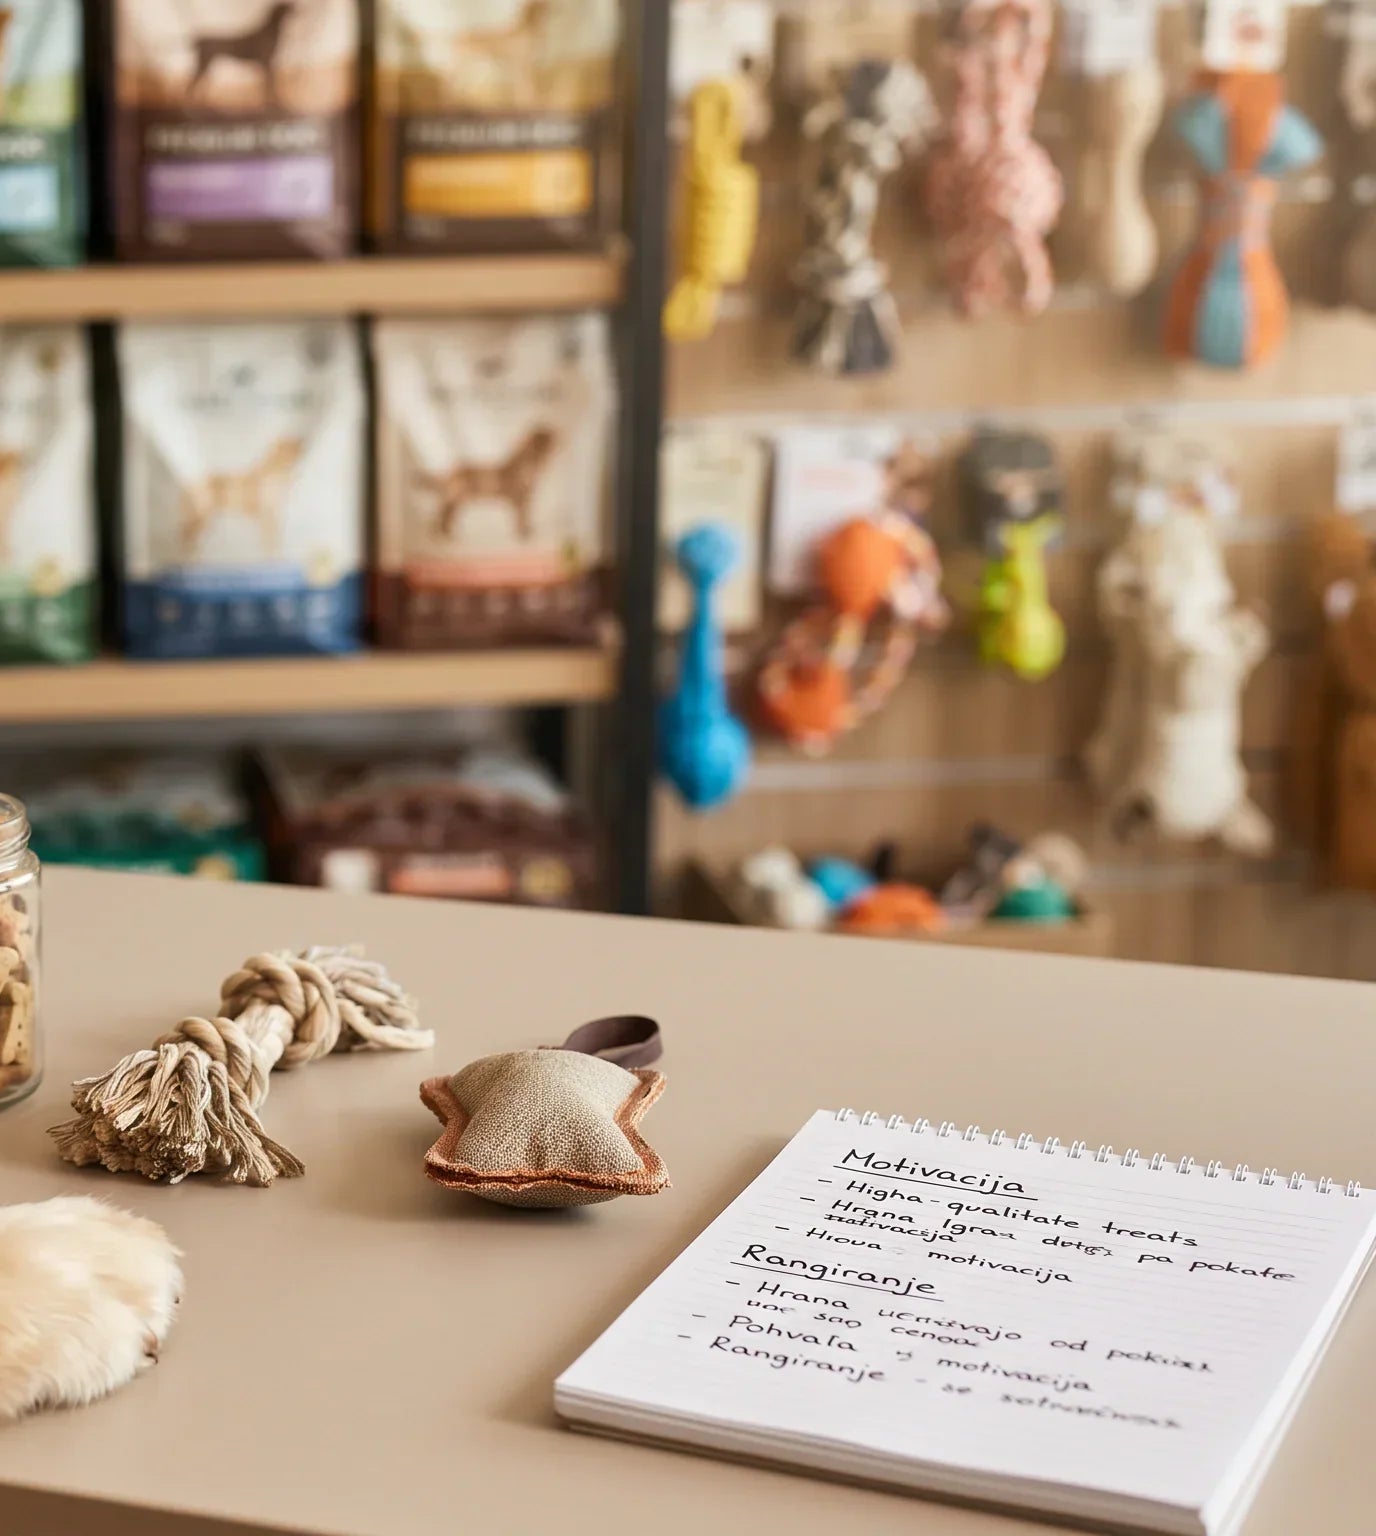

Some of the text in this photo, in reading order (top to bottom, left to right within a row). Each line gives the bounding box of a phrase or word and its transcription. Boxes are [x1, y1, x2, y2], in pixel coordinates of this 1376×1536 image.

[841, 1149, 1025, 1194] Motivacija
[831, 1199, 915, 1224] Hrana
[1137, 1254, 1174, 1264] pa
[1102, 1221, 1198, 1247] treats
[741, 1244, 936, 1296] Rangiranje
[927, 1251, 1073, 1284] motivacija
[757, 1281, 850, 1310] Hrana
[1050, 1339, 1088, 1351] od
[709, 1336, 886, 1383] Rangiranje
[728, 1315, 857, 1352] Pohvala
[937, 1358, 1093, 1393] motivacija
